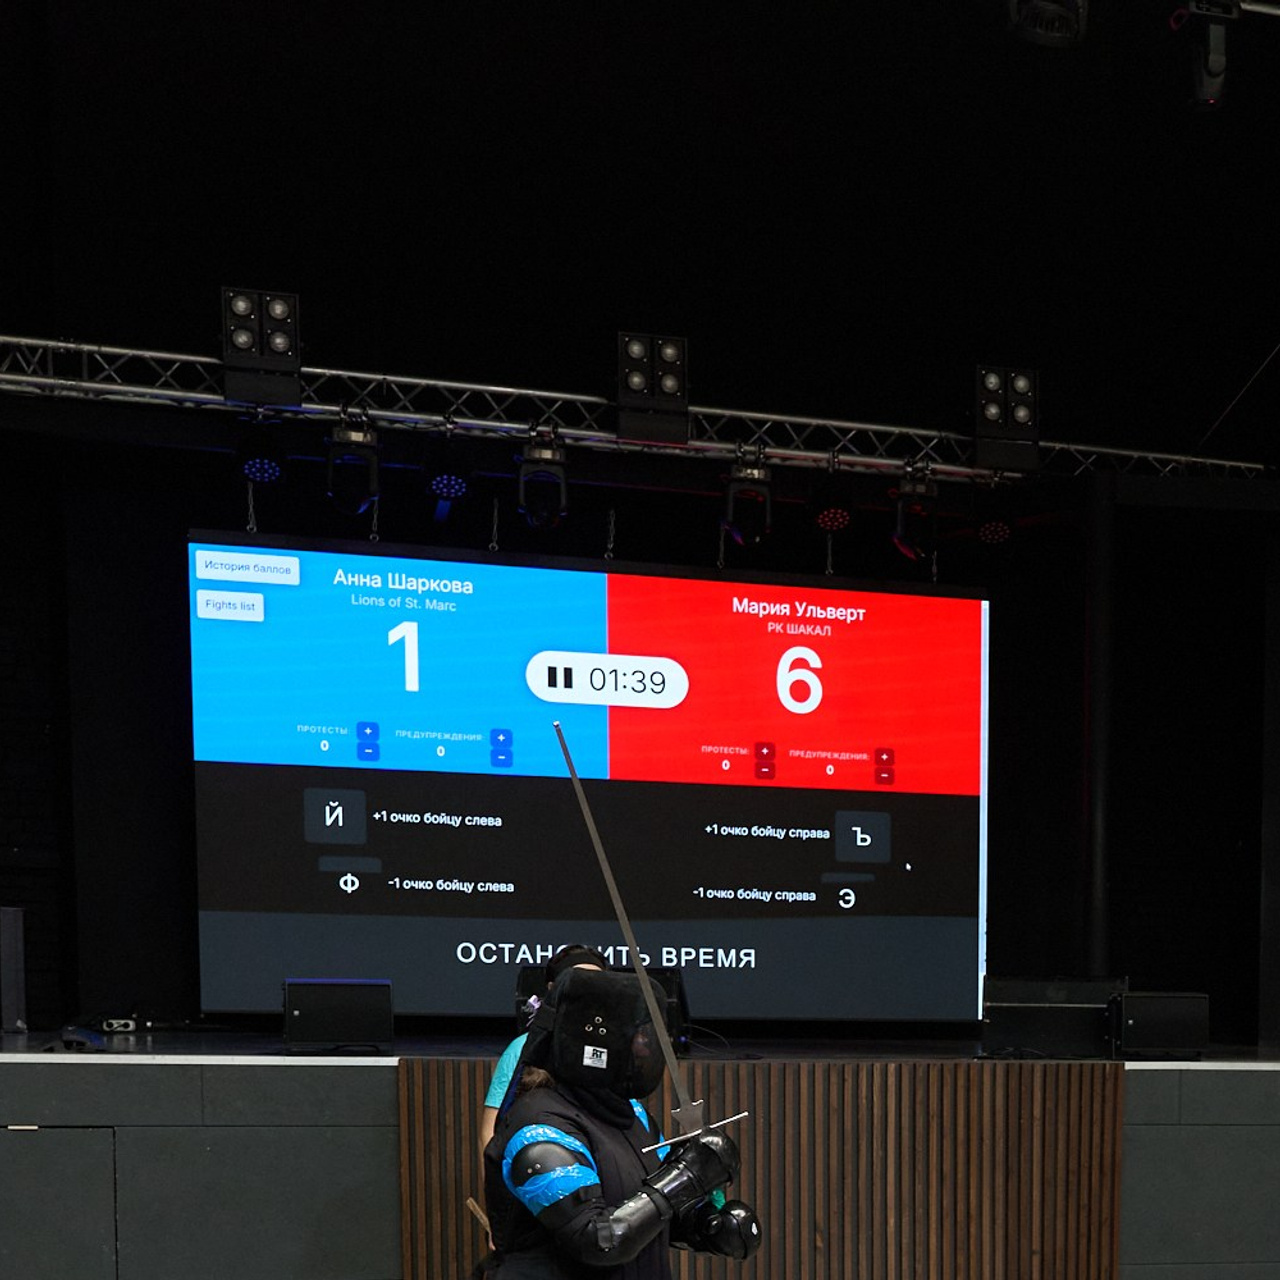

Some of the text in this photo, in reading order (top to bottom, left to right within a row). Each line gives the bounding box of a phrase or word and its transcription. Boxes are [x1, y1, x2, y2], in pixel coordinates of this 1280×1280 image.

[204, 560, 292, 575] История баллов
[333, 568, 474, 595] Анна Шаркова
[205, 599, 256, 612] Fights list
[351, 594, 457, 612] Lions of St. Marc
[732, 597, 867, 624] Мария Ульверт
[767, 621, 832, 637] РК ШАКАЛ
[387, 620, 420, 693] 1
[589, 667, 666, 695] 01:39
[775, 645, 824, 715] 6
[320, 739, 330, 752] 0
[436, 745, 446, 758] 0
[721, 758, 731, 771] 0
[825, 763, 835, 776] 0
[324, 800, 344, 827] Й
[372, 810, 503, 828] +1 очко бойцу слева
[704, 823, 831, 841] +1 очко бойцу справа
[851, 826, 872, 847] Ъ
[338, 872, 360, 895] Ф
[387, 877, 515, 894] -1 очко бойцу слева
[692, 886, 817, 903] -1 очко бойцу справа
[838, 888, 856, 909] Э
[456, 941, 757, 969] ОСТАНИТЬ ВРЕМЯ
